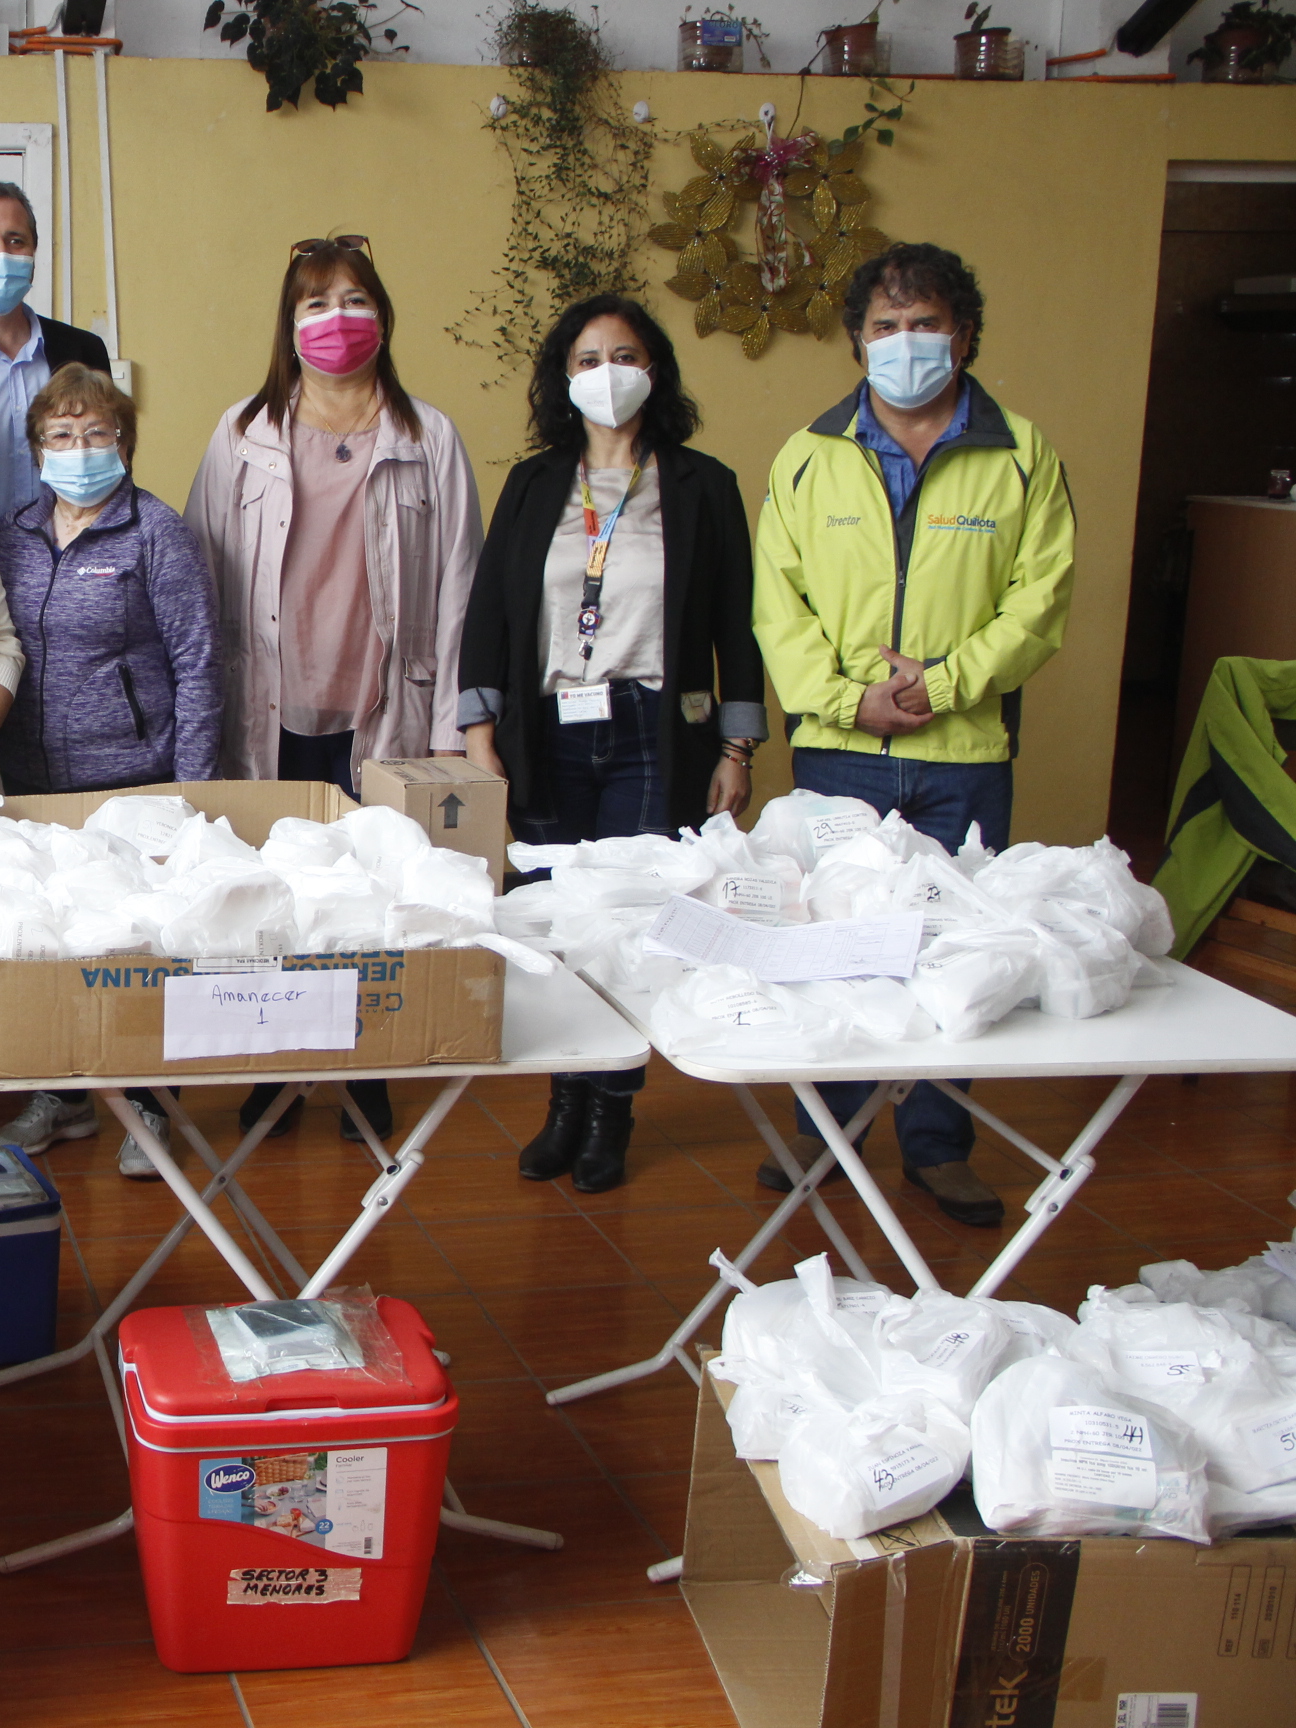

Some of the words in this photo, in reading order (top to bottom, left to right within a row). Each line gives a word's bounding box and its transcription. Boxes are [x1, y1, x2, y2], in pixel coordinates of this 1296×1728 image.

[826, 515, 861, 528] Director
[813, 822, 835, 839] 29
[722, 880, 741, 899] 17
[212, 984, 307, 1006] Amanecer
[256, 1007, 269, 1024] 1
[1082, 1439, 1111, 1447] ENTREGA
[335, 1454, 365, 1464] Cooler
[210, 1470, 250, 1489] Wenco
[873, 1468, 895, 1492] 43
[318, 1521, 330, 1529] 22
[241, 1569, 309, 1582] SECTOR
[315, 1569, 329, 1583] 3
[242, 1583, 326, 1597] MENORES
[1016, 1617, 1035, 1653] 2000
[1026, 1569, 1041, 1615] UNIDADES
